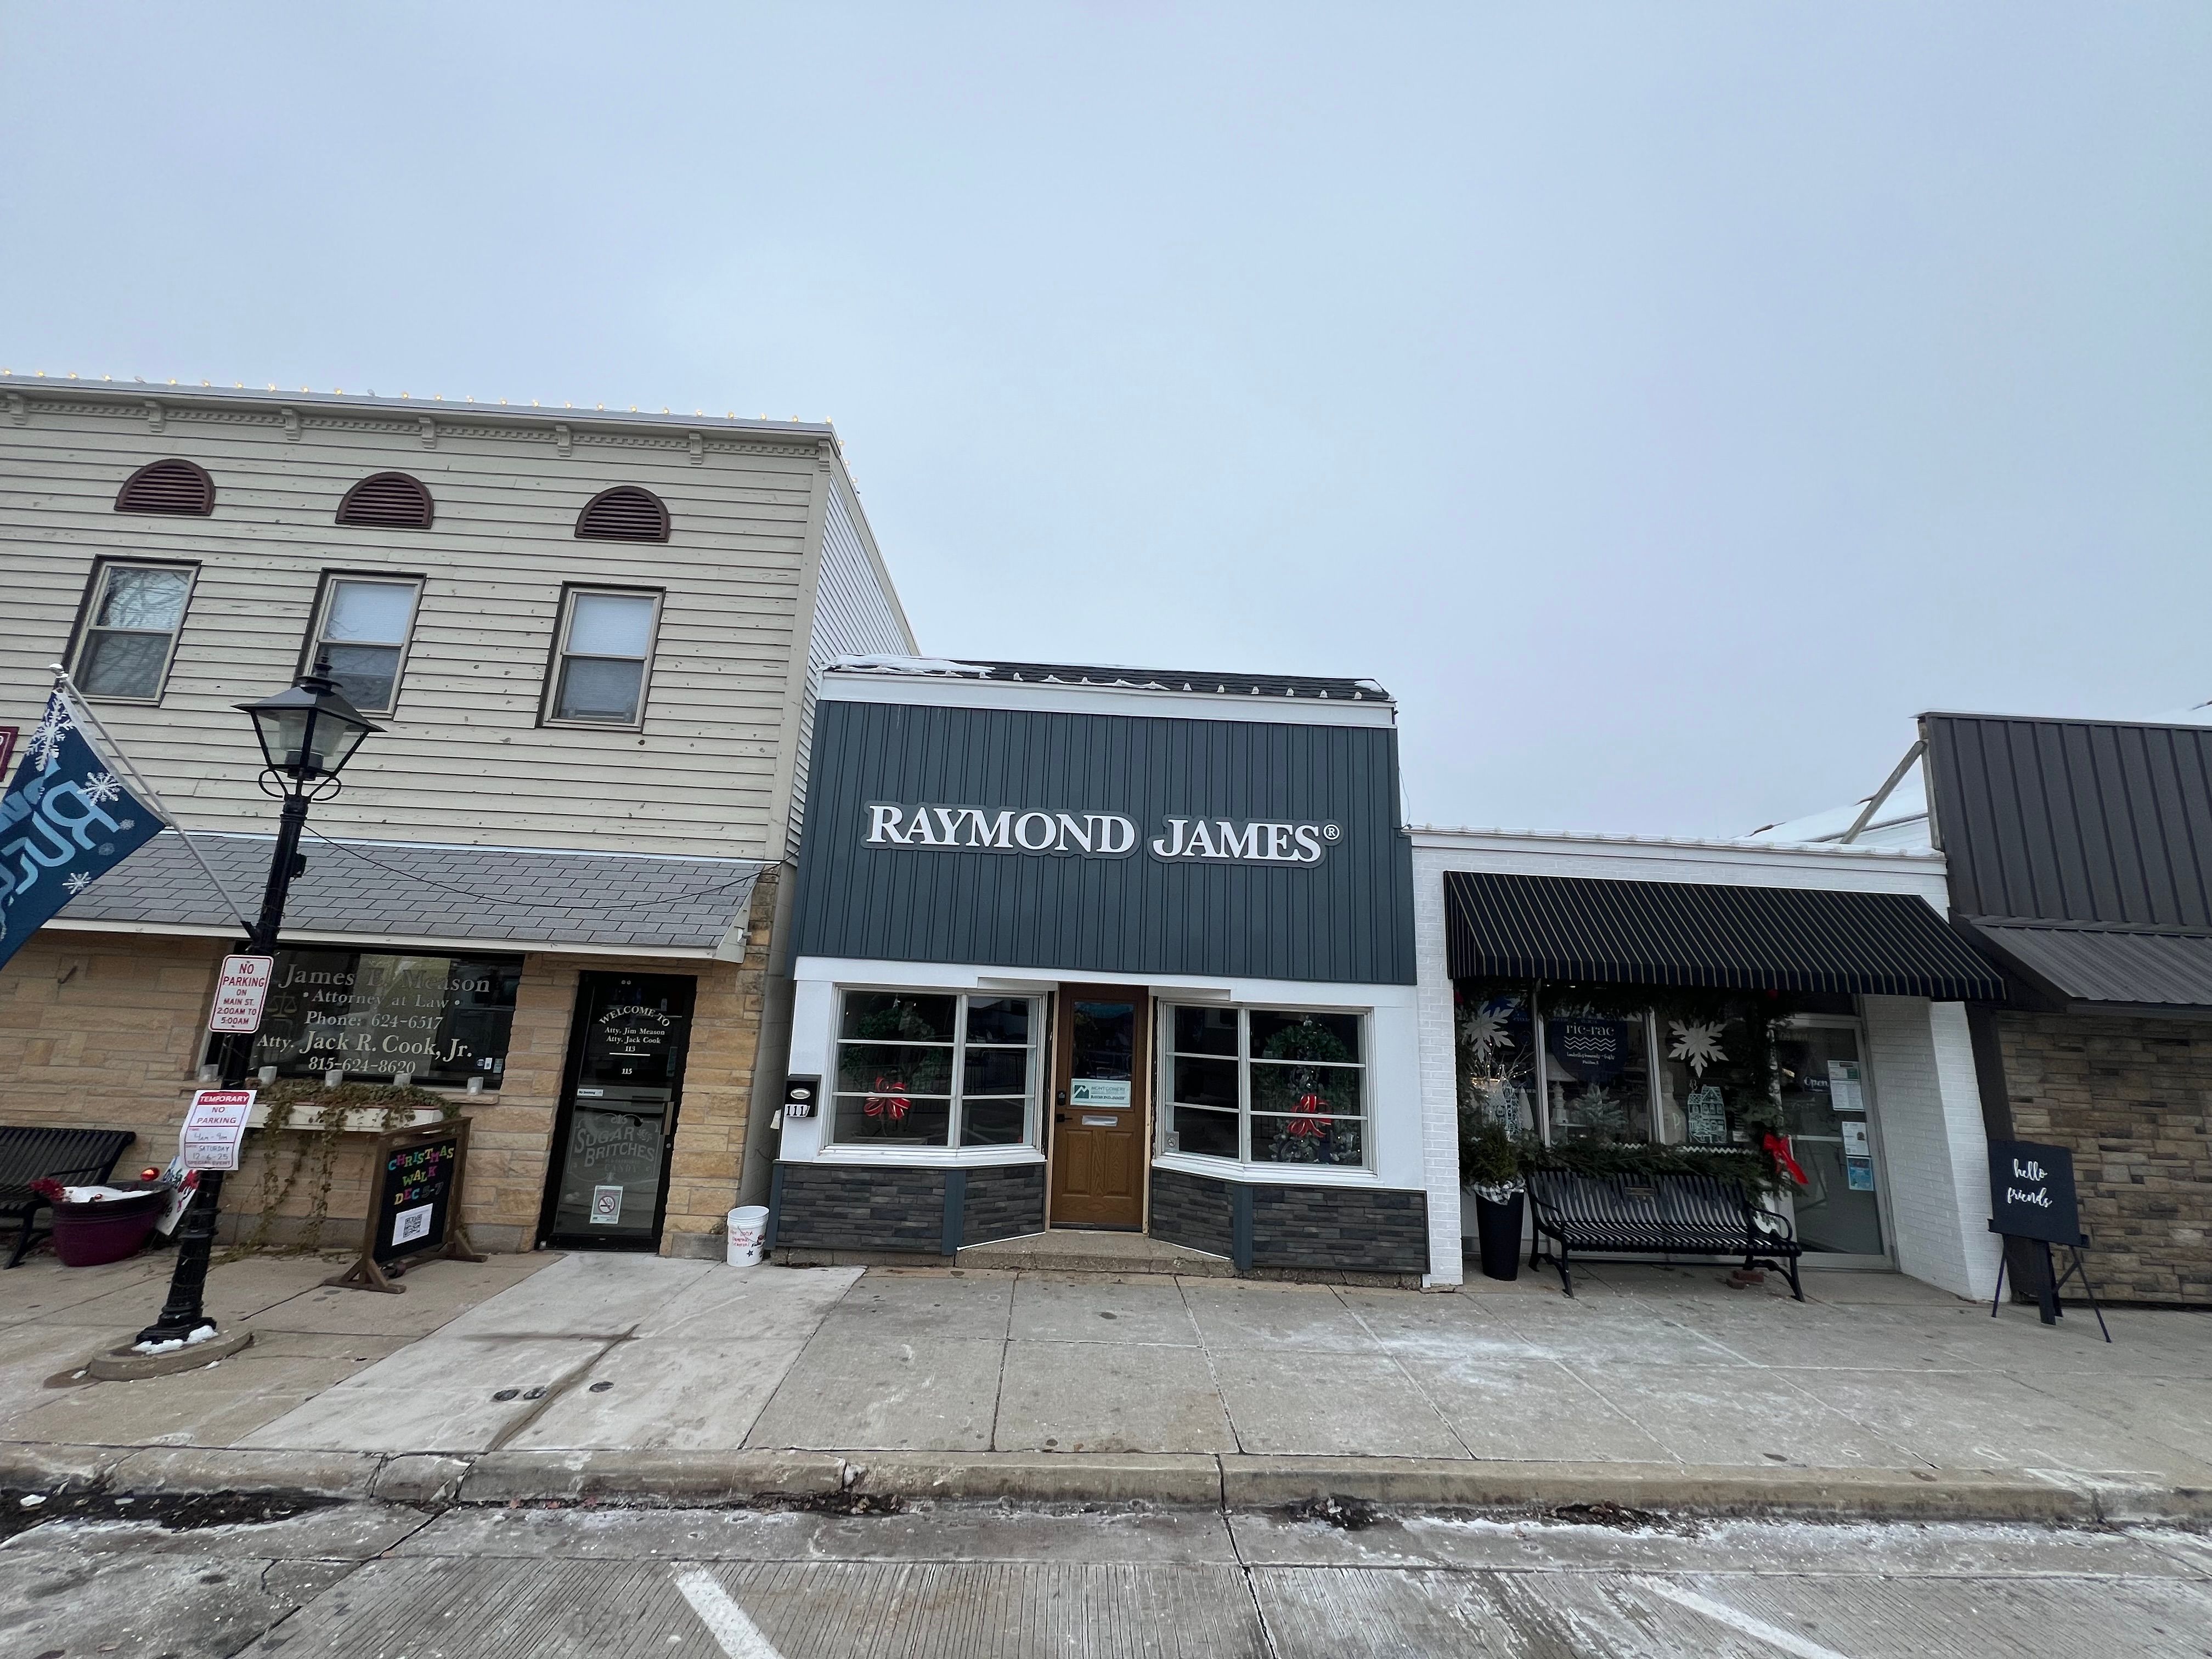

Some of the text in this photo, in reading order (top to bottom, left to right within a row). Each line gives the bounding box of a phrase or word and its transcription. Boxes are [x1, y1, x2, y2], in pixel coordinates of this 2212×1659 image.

[866, 804, 1136, 854] RAYMOND
[239, 963, 254, 974] NO
[278, 963, 356, 988] James
[402, 969, 490, 992] Meason
[222, 976, 266, 987] PARKING
[312, 989, 449, 1009] Attorney at Law
[304, 1011, 444, 1030] Phone: 624-6517
[599, 1006, 670, 1026] WELCOME TO
[1566, 1022, 1615, 1036] ric-rac
[257, 1031, 472, 1062] Atty. Jack R. Cook, Jr.
[606, 1036, 623, 1044] Atty.
[624, 1036, 641, 1044] Jack
[308, 1056, 416, 1074] 815-624-8620
[1803, 1076, 1829, 1088] Open
[574, 1127, 634, 1153] SUGAR
[388, 1146, 454, 1171] CHRISTMAS
[584, 1142, 655, 1167] BRITCHES
[402, 1166, 438, 1187] WALK
[2013, 1158, 2048, 1181] hello
[394, 1182, 444, 1205] DEC 5-7
[2007, 1187, 2053, 1208] friends
